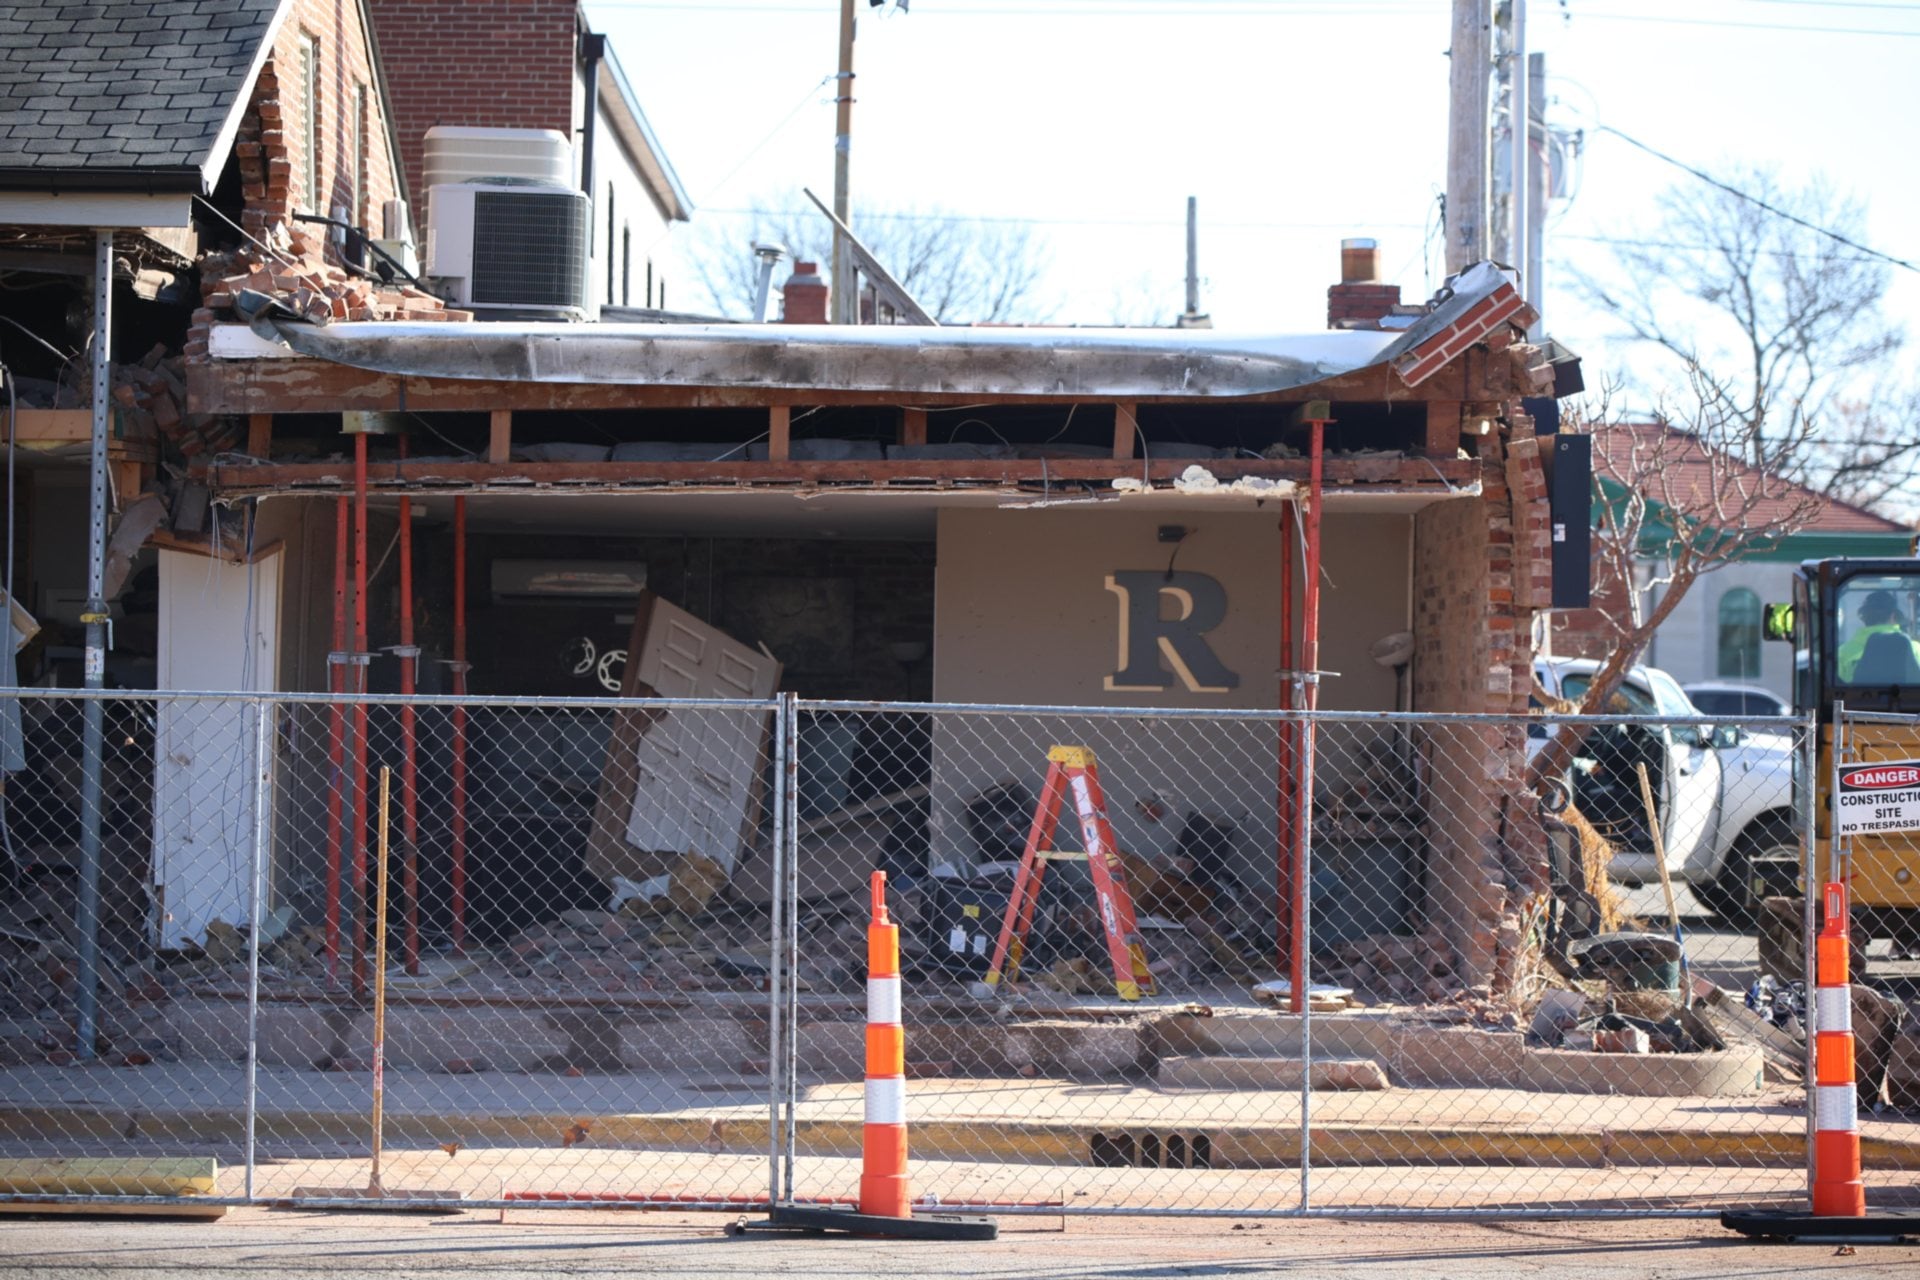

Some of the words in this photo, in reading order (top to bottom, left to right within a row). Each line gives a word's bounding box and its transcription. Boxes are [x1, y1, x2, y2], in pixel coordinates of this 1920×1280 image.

[1104, 570, 1240, 692] R
[1854, 770, 1919, 785] DANGER
[1875, 807, 1902, 819] SITE
[1842, 823, 1858, 832] NO
[1861, 819, 1920, 831] TRESPASSI
